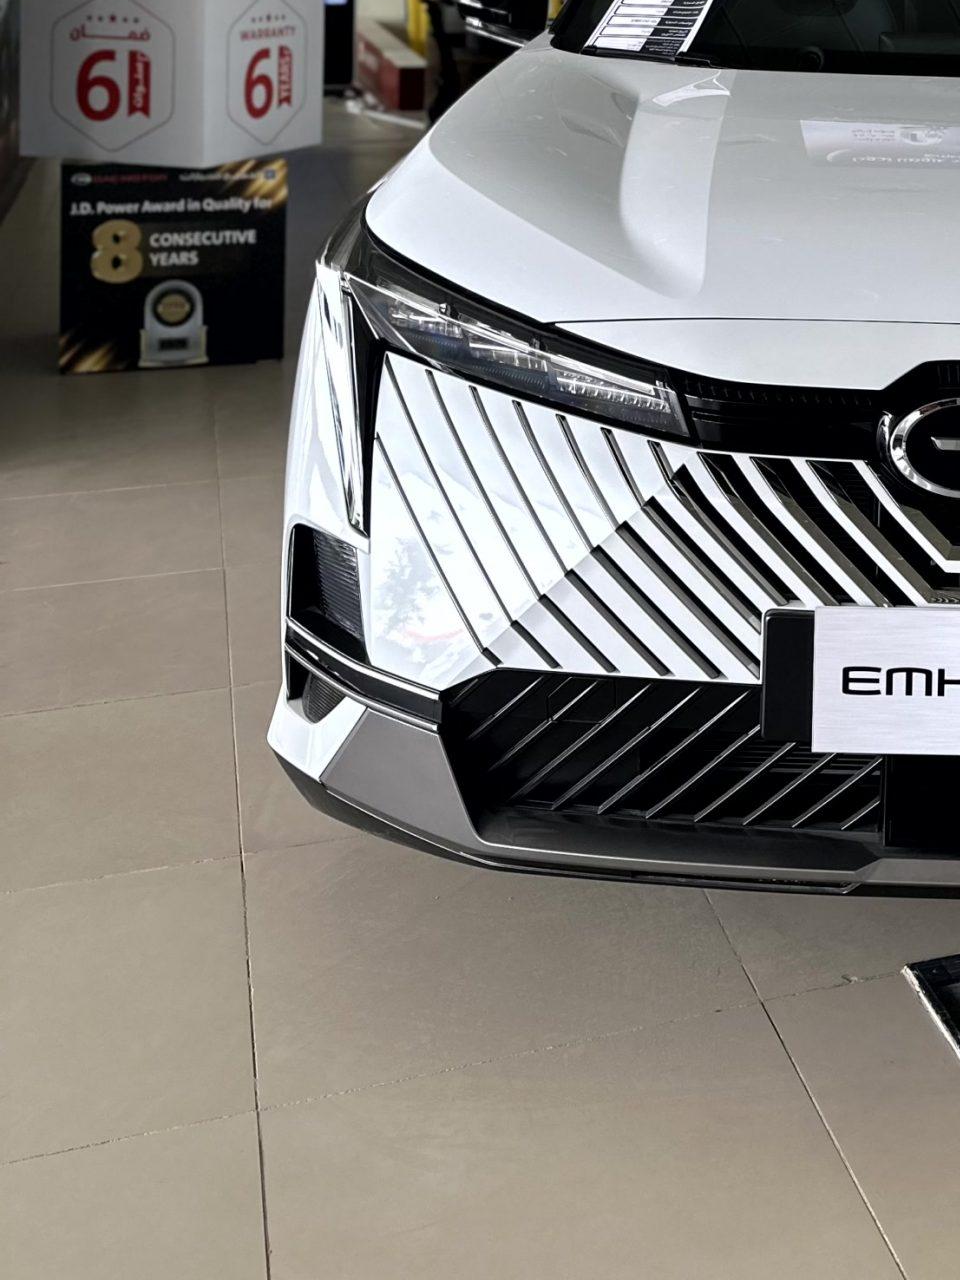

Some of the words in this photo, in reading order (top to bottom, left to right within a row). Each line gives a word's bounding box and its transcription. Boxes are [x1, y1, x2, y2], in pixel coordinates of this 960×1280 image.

[76, 49, 122, 122] 6
[243, 47, 274, 119] 6
[70, 201, 95, 216] J.D.
[97, 200, 140, 215] Power
[141, 198, 186, 214] Award
[187, 197, 200, 211] in
[202, 197, 251, 214] Quality
[253, 196, 273, 210] for
[90, 218, 145, 285] 8
[149, 250, 200, 268] YEARS
[150, 229, 257, 248] CONSECUTIVE
